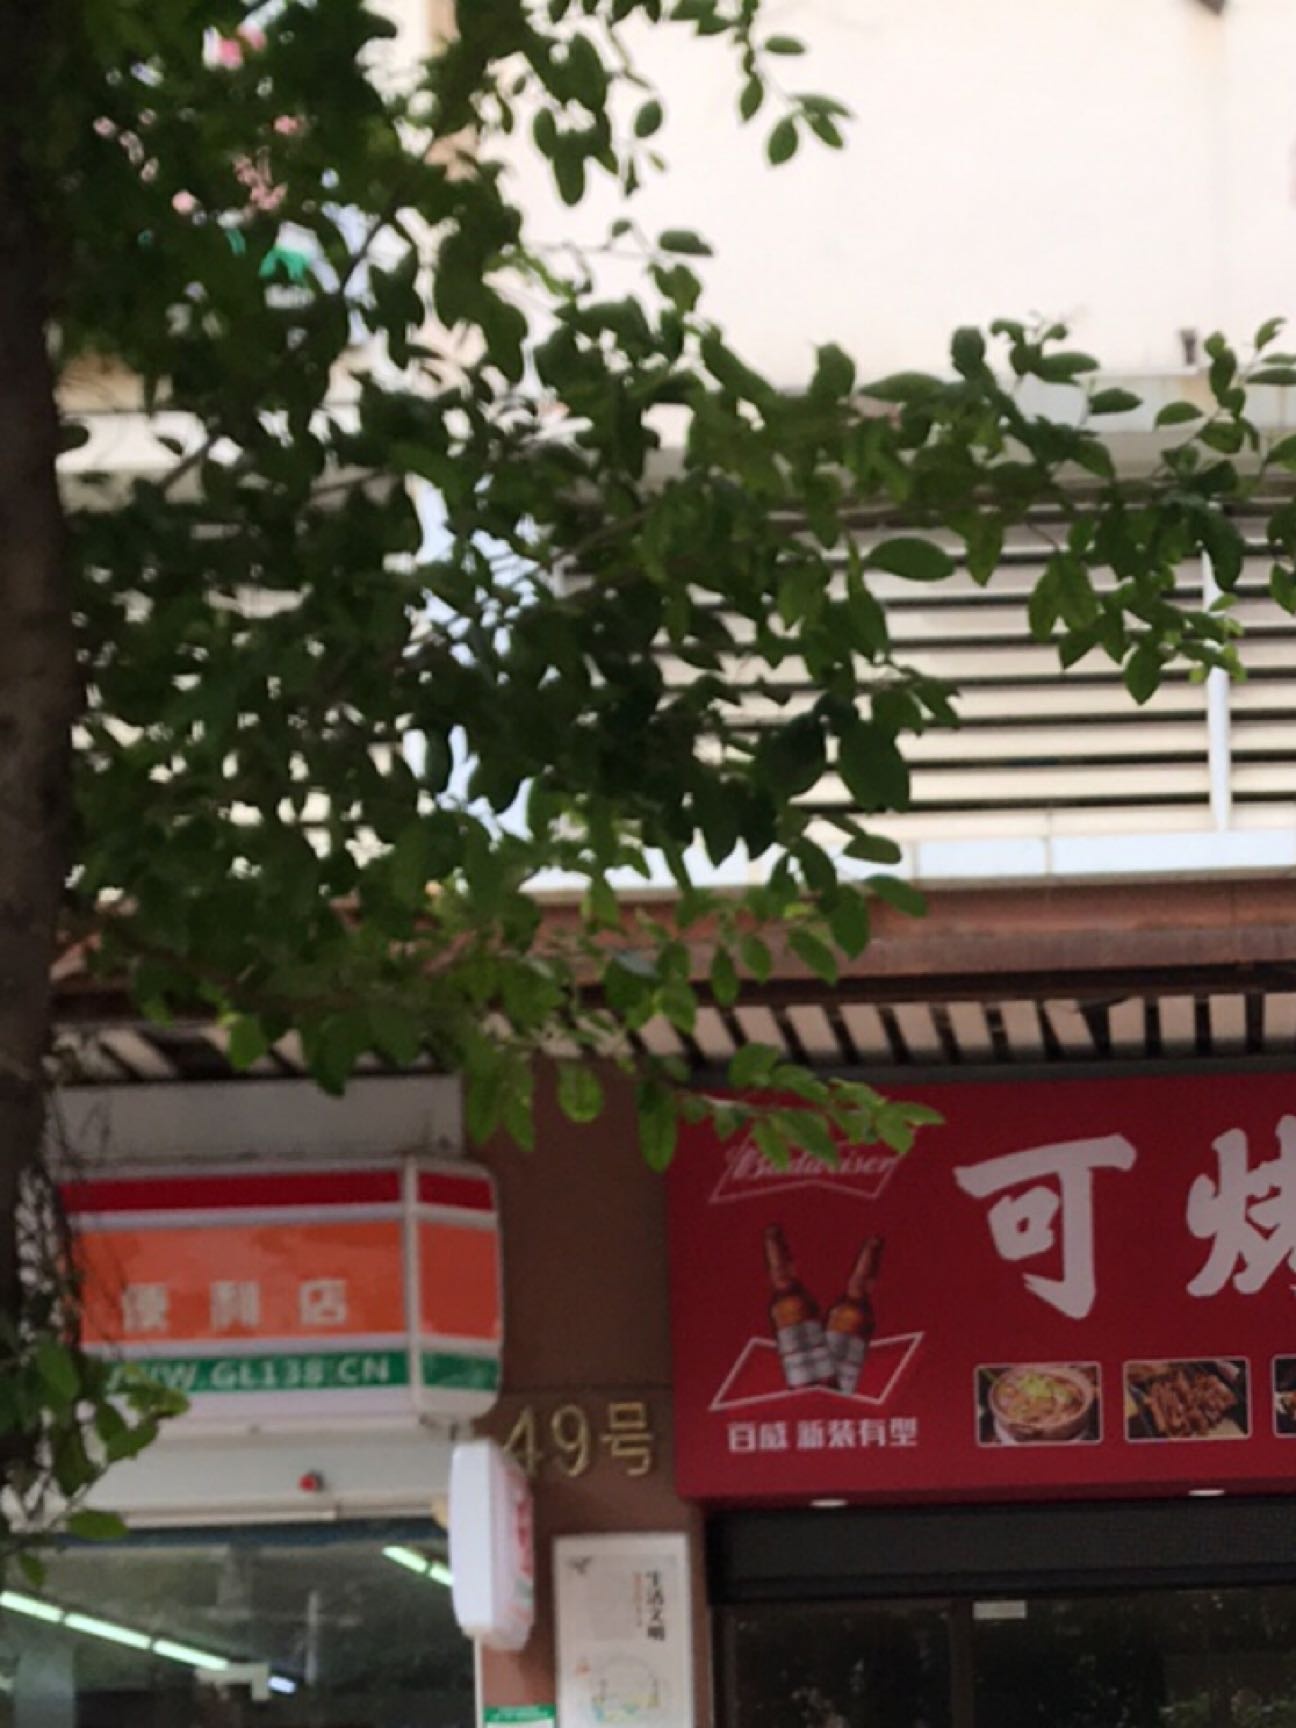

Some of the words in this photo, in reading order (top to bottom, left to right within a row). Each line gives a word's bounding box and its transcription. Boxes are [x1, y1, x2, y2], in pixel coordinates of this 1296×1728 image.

[121, 1278, 346, 1332] 便利店
[503, 1402, 654, 1477] 49号
